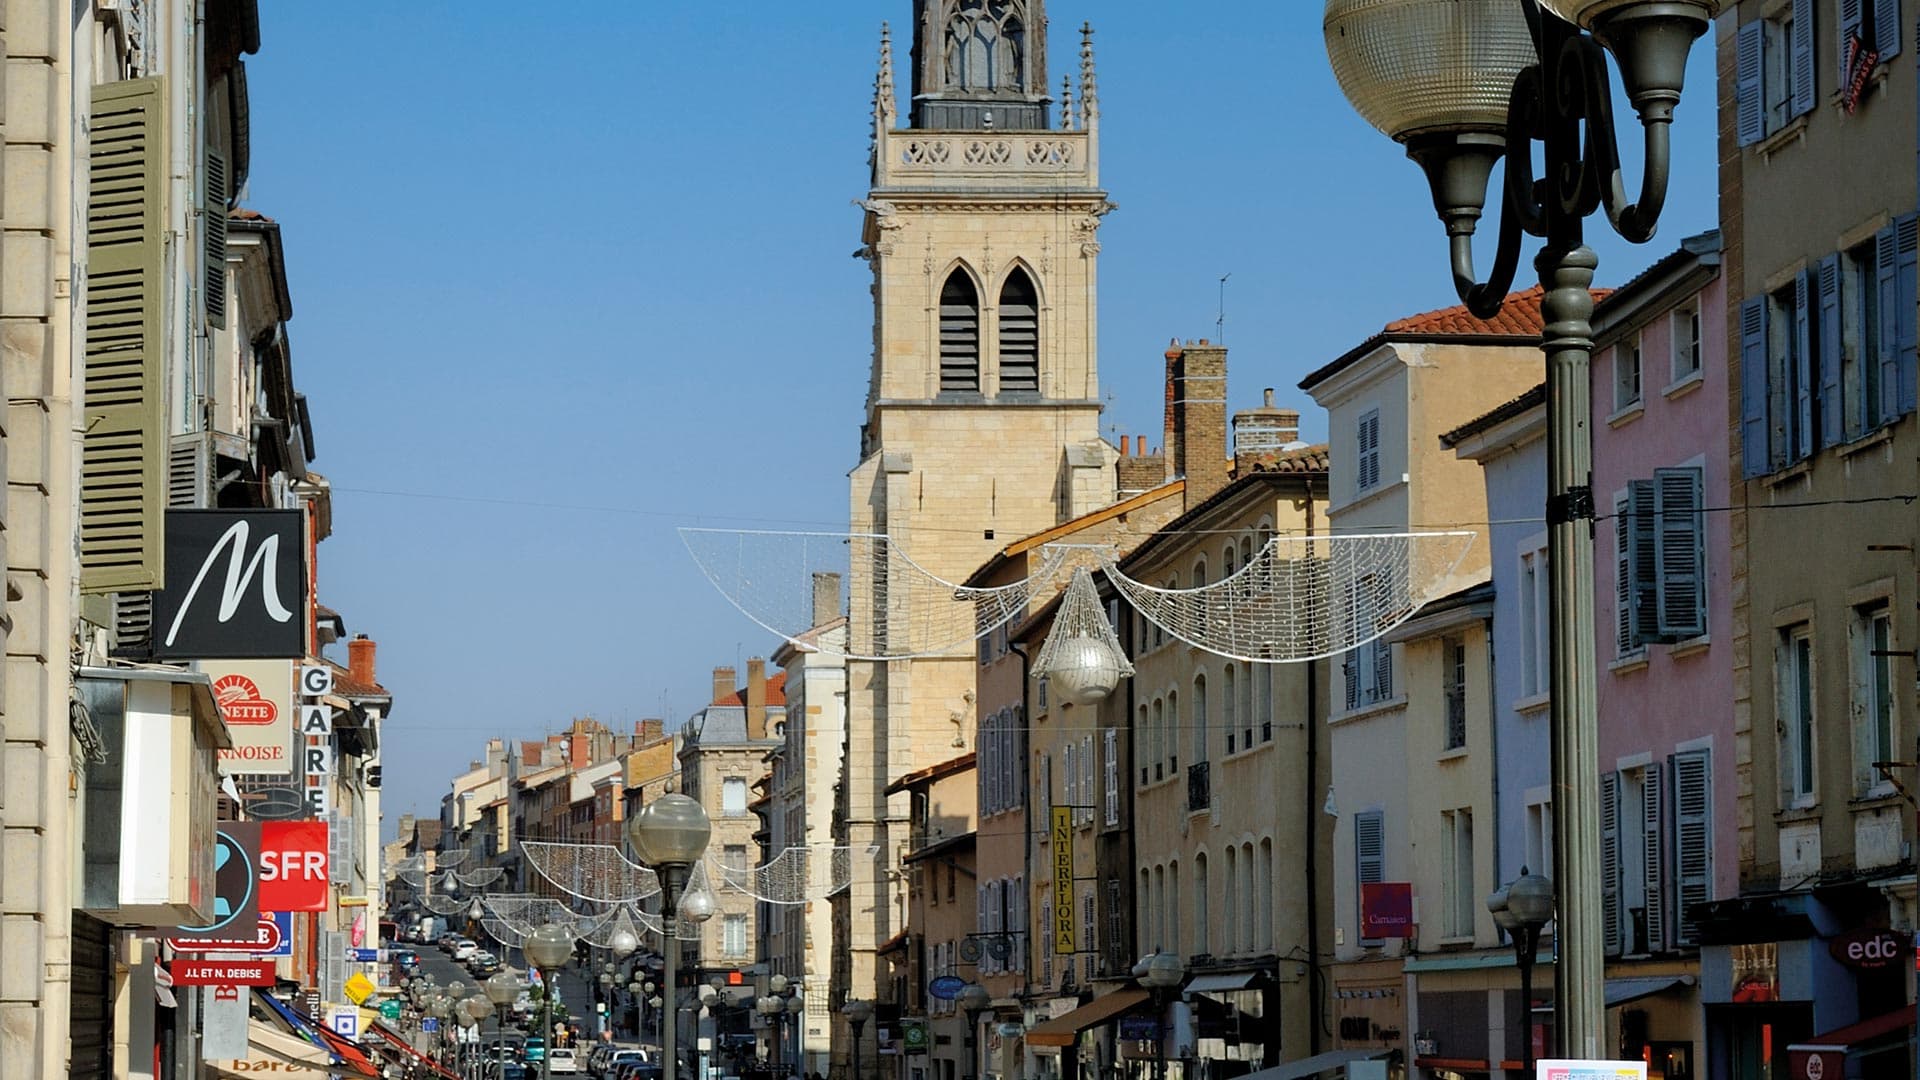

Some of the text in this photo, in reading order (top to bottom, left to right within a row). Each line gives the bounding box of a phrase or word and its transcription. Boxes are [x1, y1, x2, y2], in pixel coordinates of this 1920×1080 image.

[304, 669, 328, 812] GARE
[259, 851, 326, 881] SFR
[1056, 815, 1072, 945] INTERFLORA
[1847, 936, 1897, 960] edc
[201, 968, 213, 978] ET
[214, 968, 225, 978] N.
[227, 968, 262, 979] DEBISE
